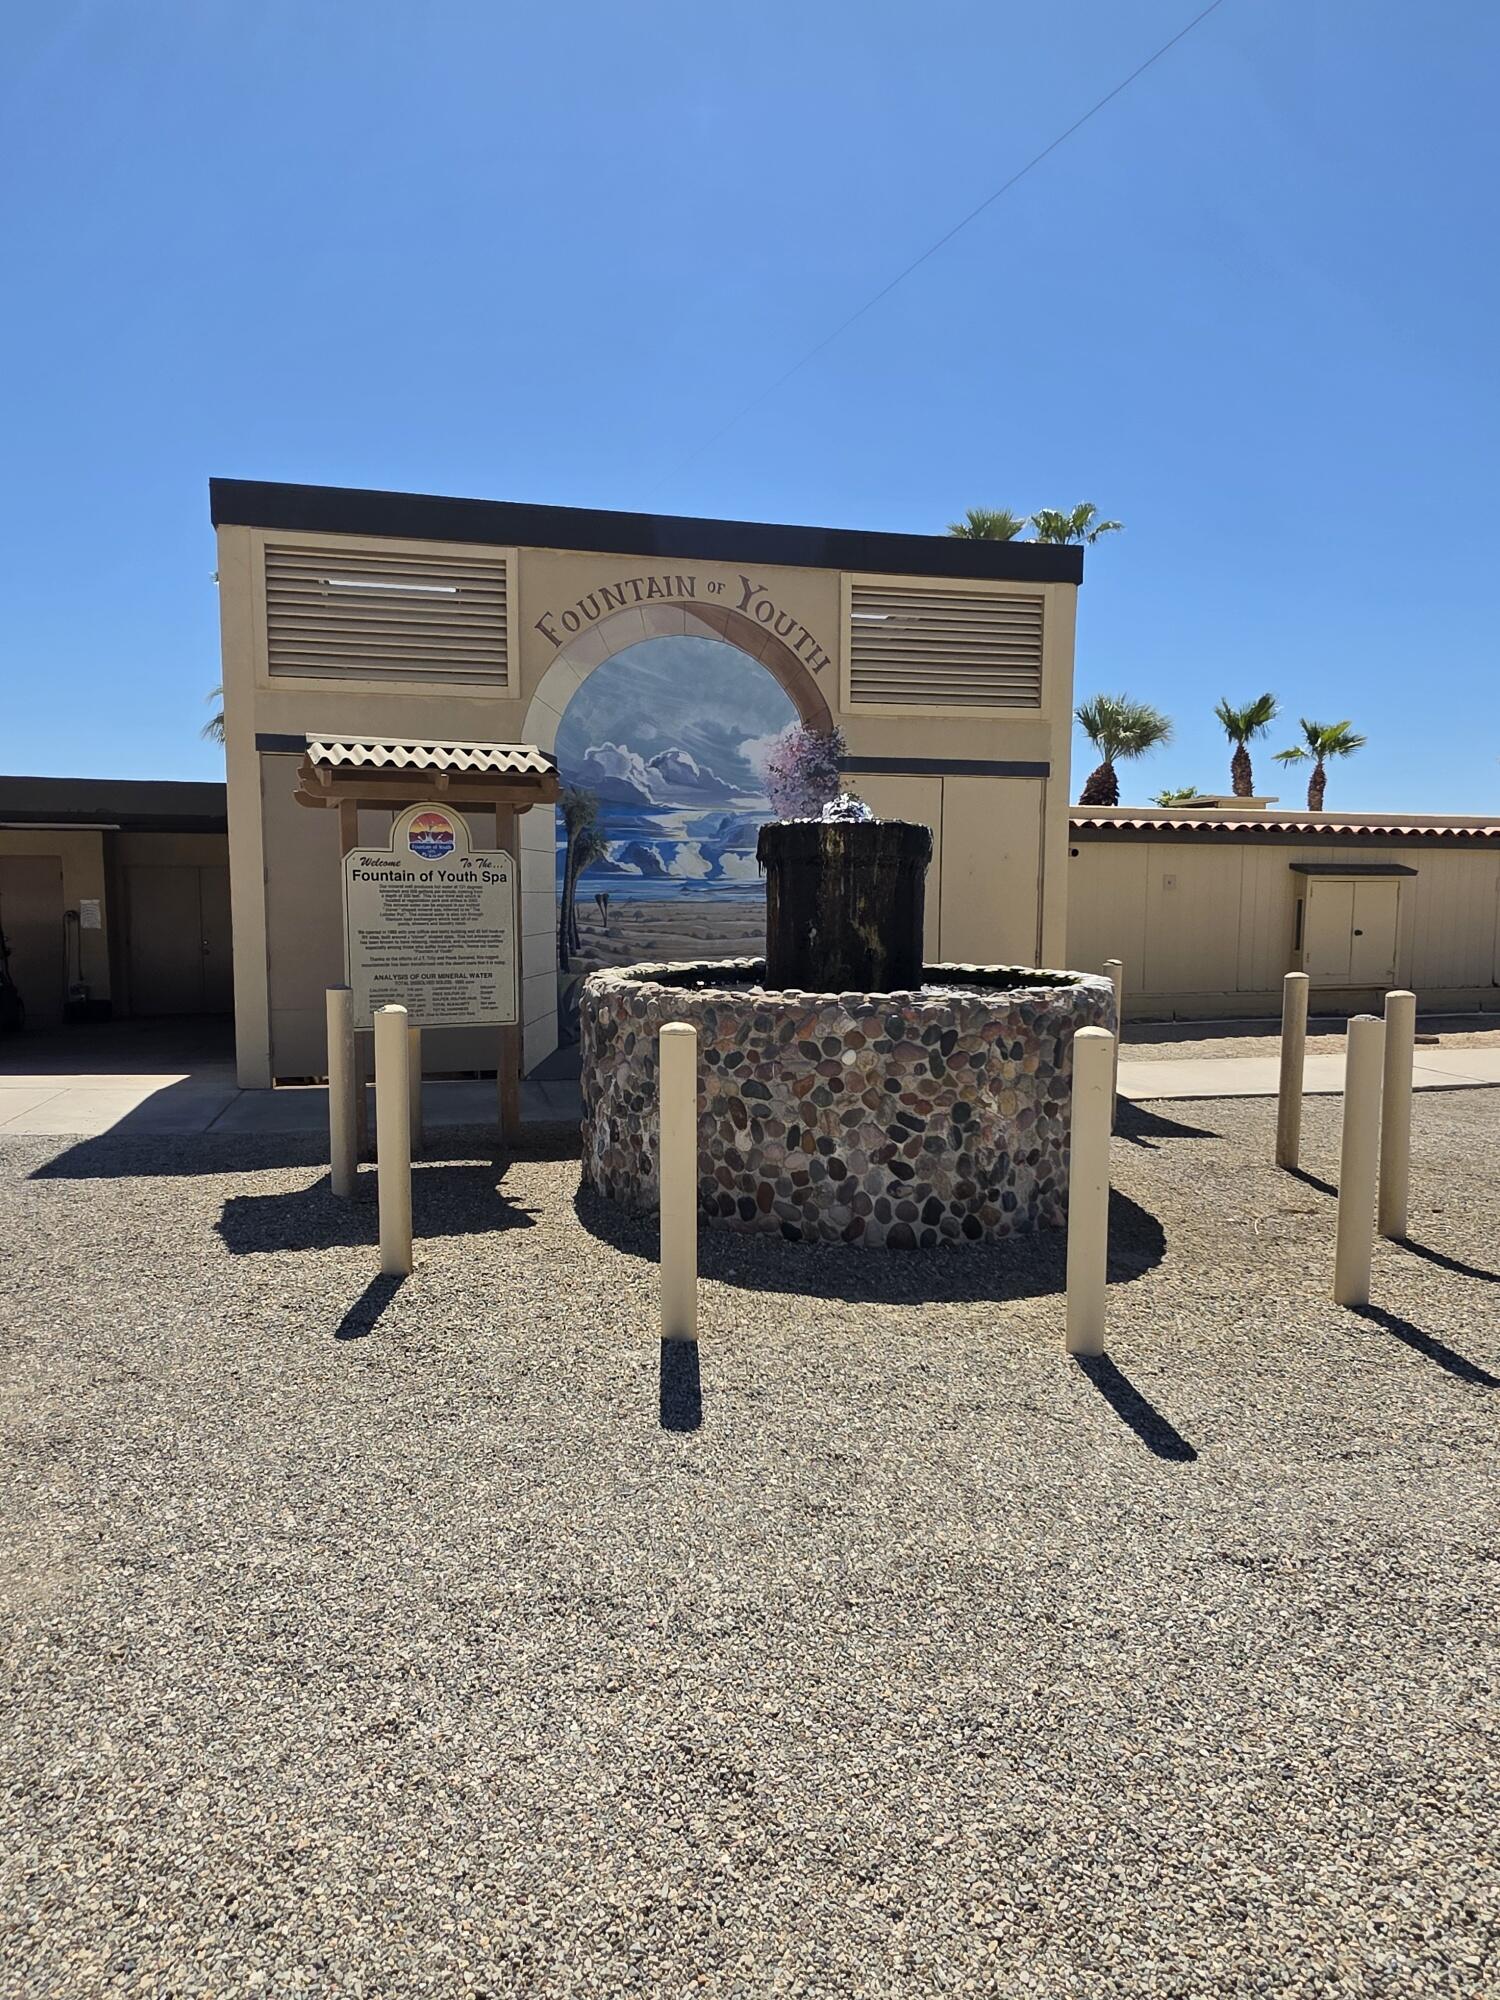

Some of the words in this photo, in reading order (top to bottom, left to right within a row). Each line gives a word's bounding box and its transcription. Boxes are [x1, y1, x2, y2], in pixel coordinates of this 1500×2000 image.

[534, 575, 696, 648] FOUNTAIN
[707, 580, 726, 595] OF
[735, 574, 831, 675] YOUTH
[360, 857, 400, 866] Welcome
[460, 858, 472, 868] To
[352, 870, 415, 882] Fountain
[420, 870, 433, 882] of
[438, 870, 478, 882] Youth
[482, 871, 507, 885] Spa
